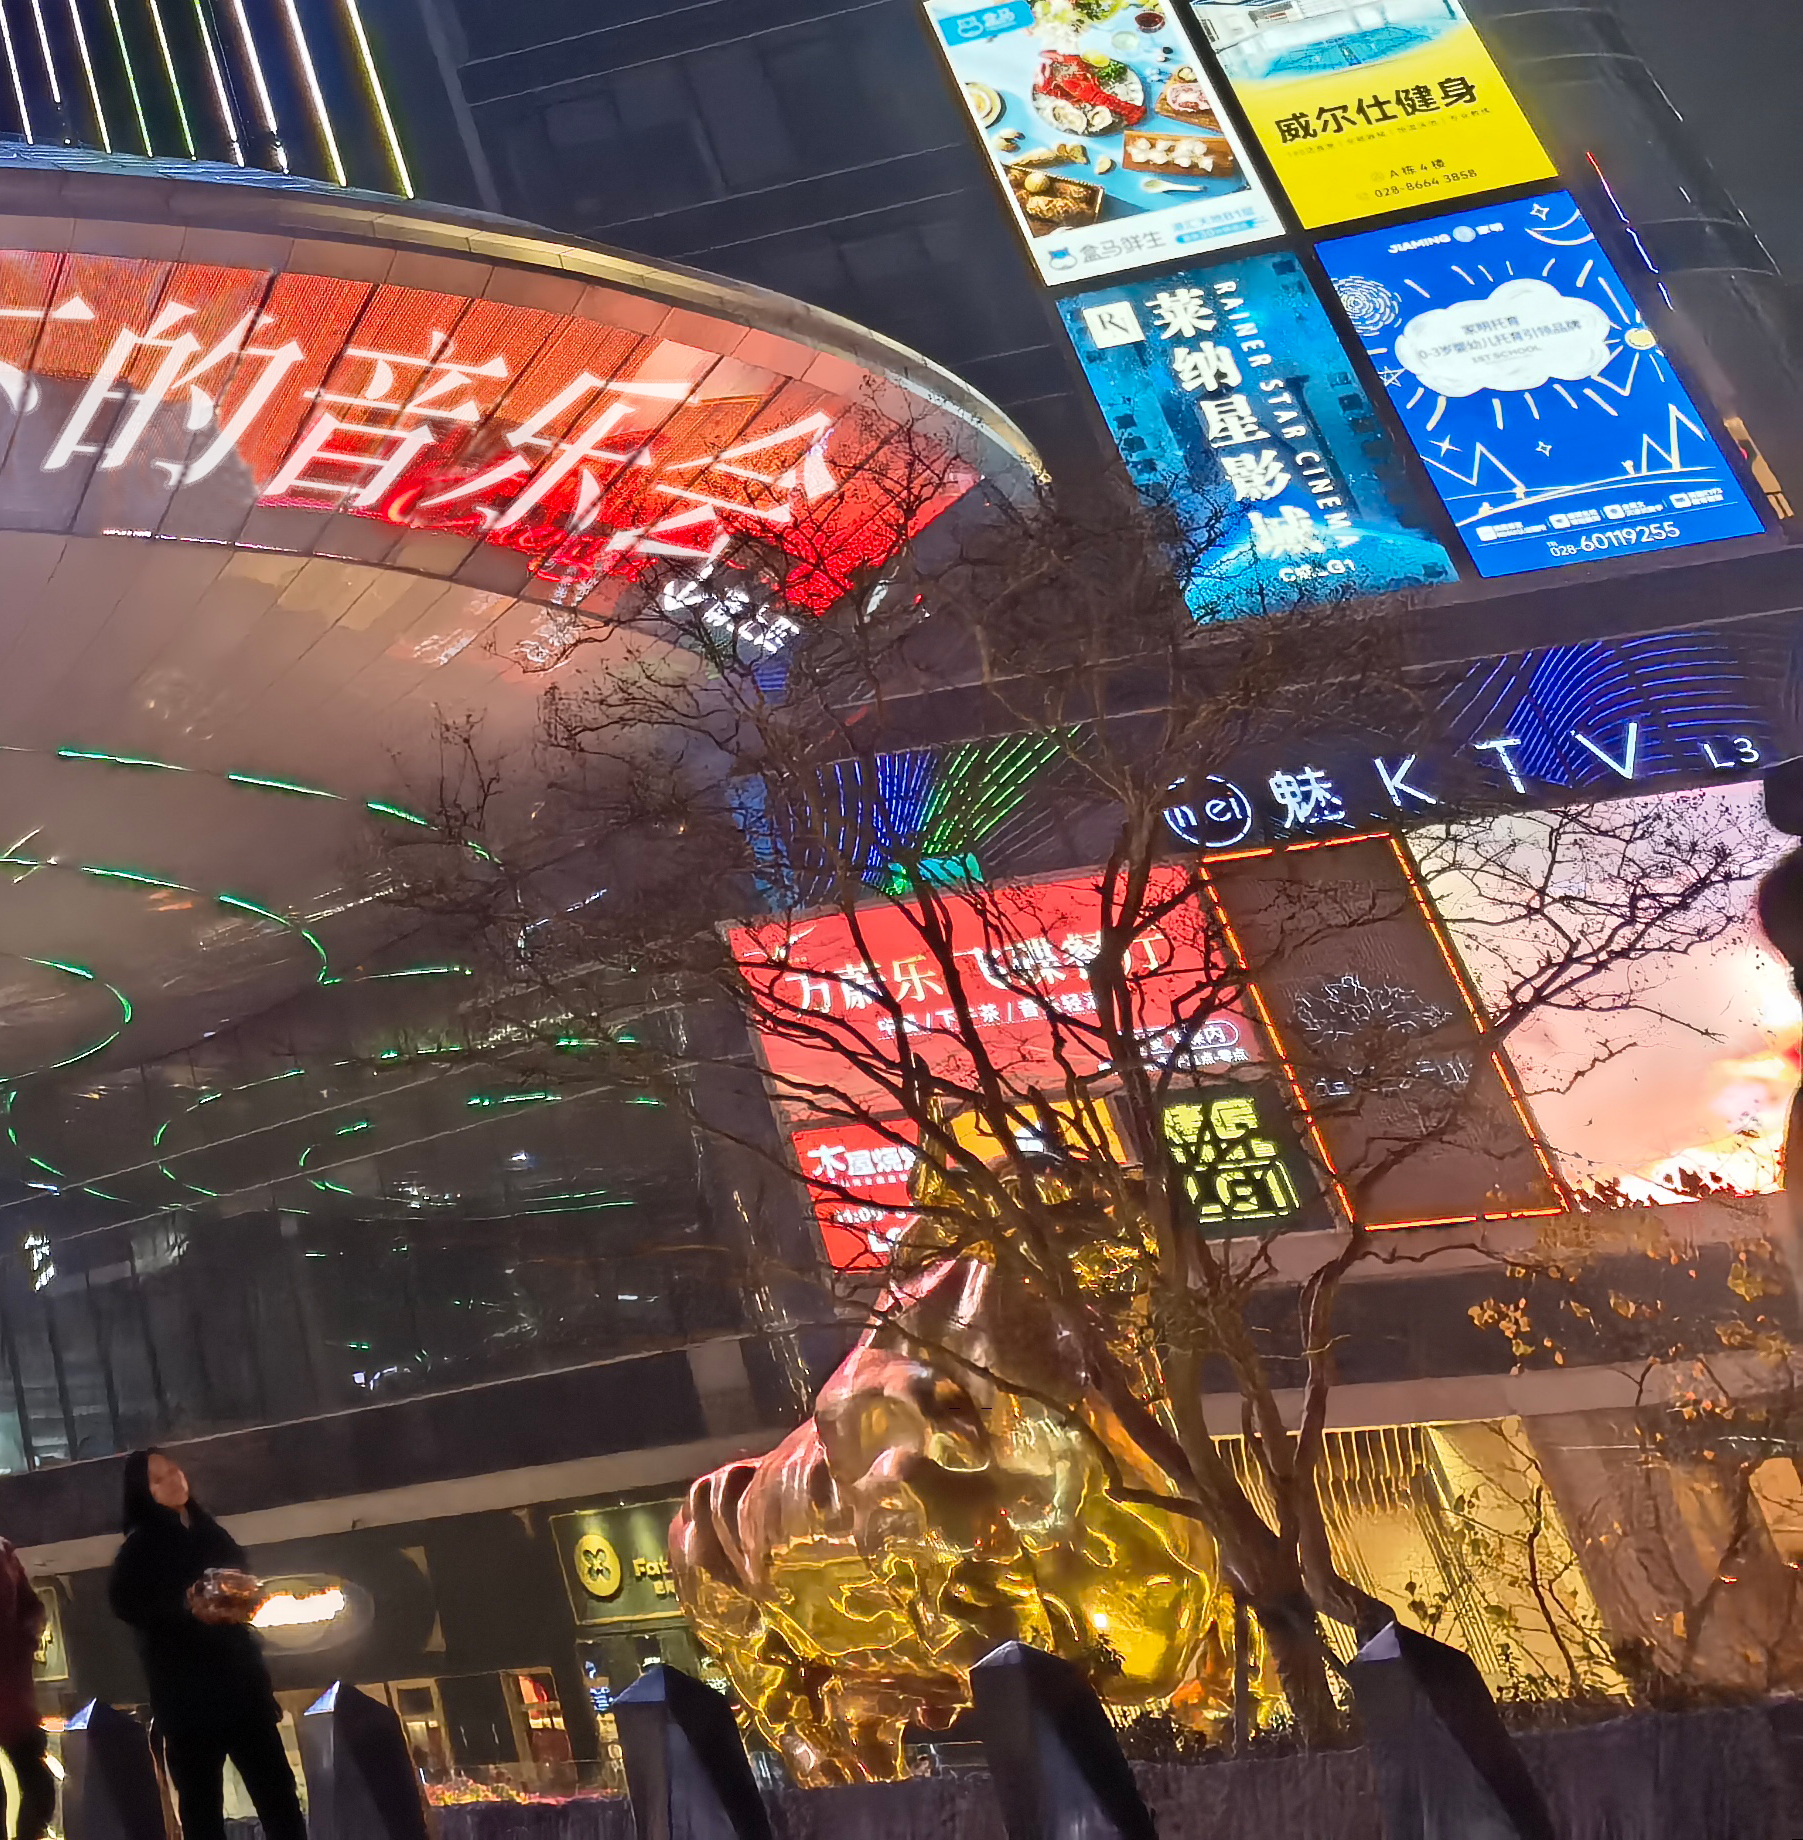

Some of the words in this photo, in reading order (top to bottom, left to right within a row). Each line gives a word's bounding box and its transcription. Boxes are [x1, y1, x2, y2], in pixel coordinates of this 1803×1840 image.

[1274, 76, 1478, 144] 威尔仕健身
[1374, 178, 1440, 199] 028-8664
[1444, 168, 1478, 185] 3858
[1080, 230, 1166, 264] 盒马鲜生
[1145, 287, 1326, 559] 莱纳星影城
[1213, 280, 1273, 368] RAINER
[1259, 377, 1307, 439] STAR
[1294, 450, 1361, 548] CINEMA
[1549, 521, 1681, 557] 028-60119255
[1703, 737, 1761, 769] L3
